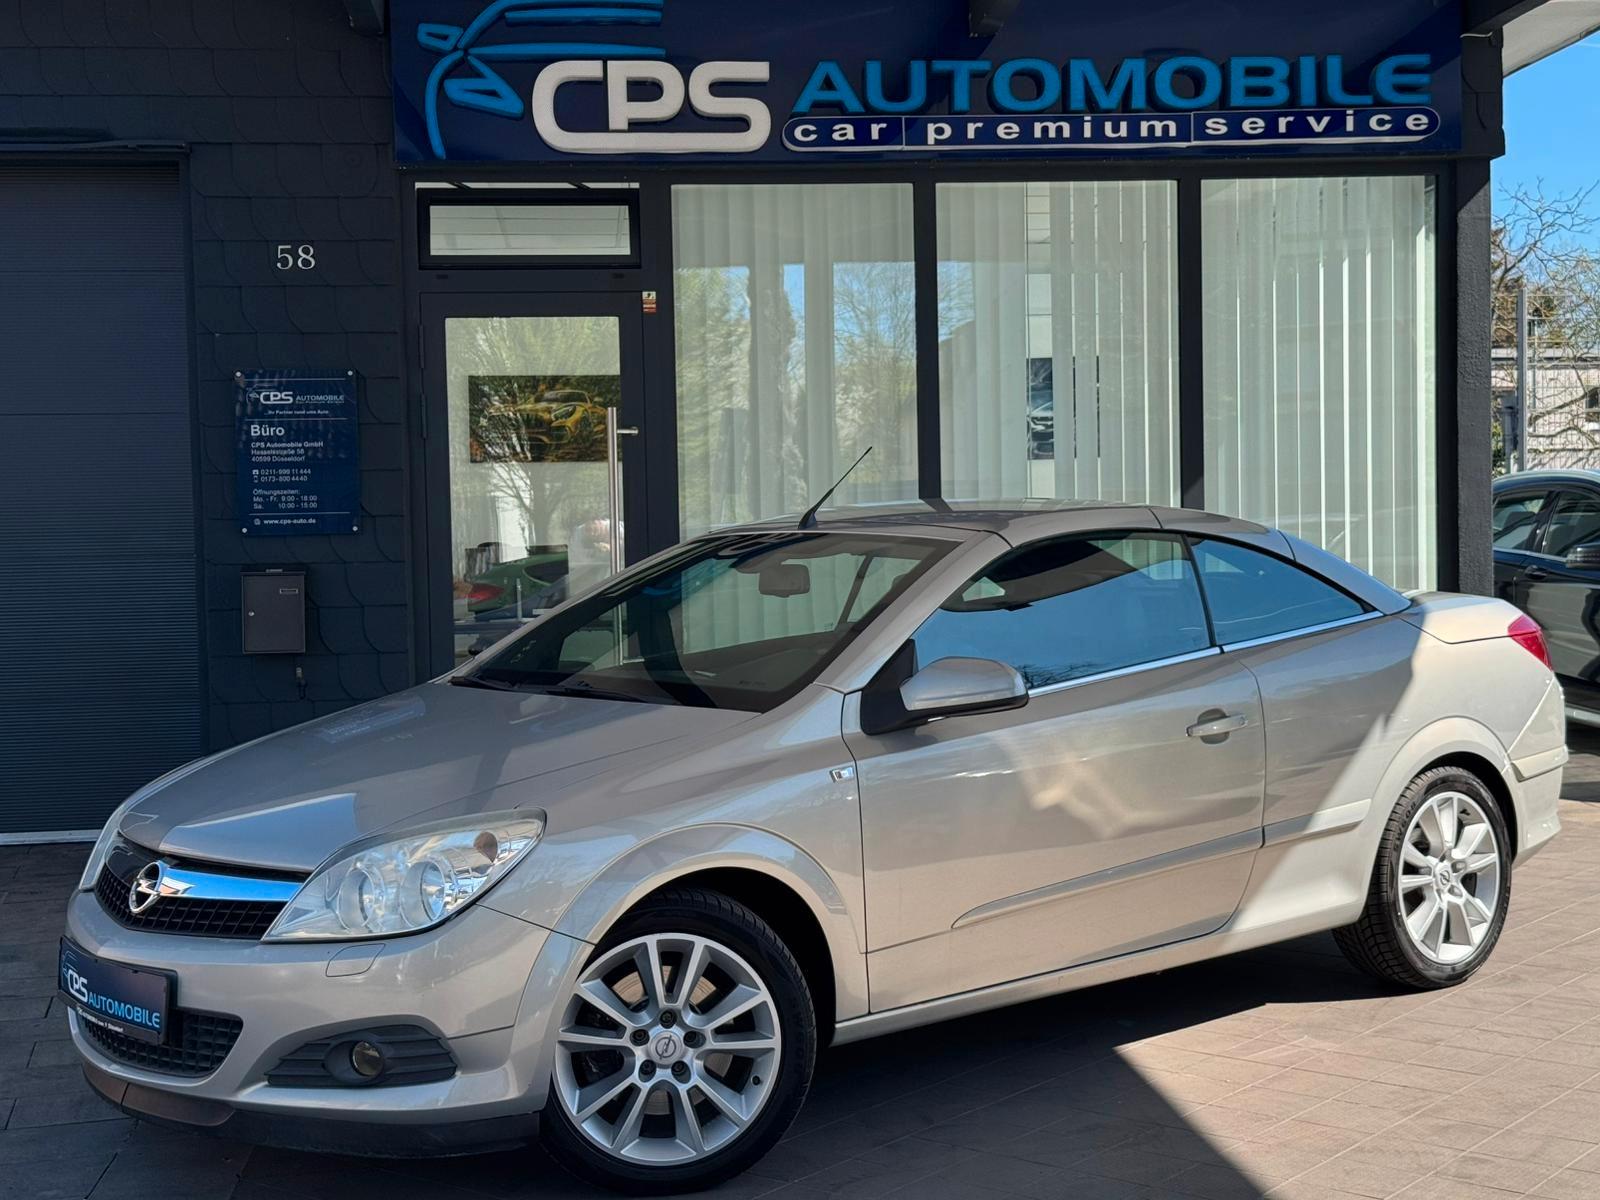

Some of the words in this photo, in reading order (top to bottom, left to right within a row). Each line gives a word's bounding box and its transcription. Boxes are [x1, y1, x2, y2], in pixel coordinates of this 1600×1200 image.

[532, 60, 771, 154] CPS
[791, 54, 1432, 114] AUTOMOBILE
[793, 122, 887, 142] car
[927, 115, 1178, 145] premium
[1204, 112, 1430, 136] service
[276, 244, 316, 270] 58
[260, 392, 294, 404] CPS
[250, 424, 285, 436] Büro
[67, 968, 88, 1003] CPS
[88, 992, 161, 1029] AUTOMOBILE
